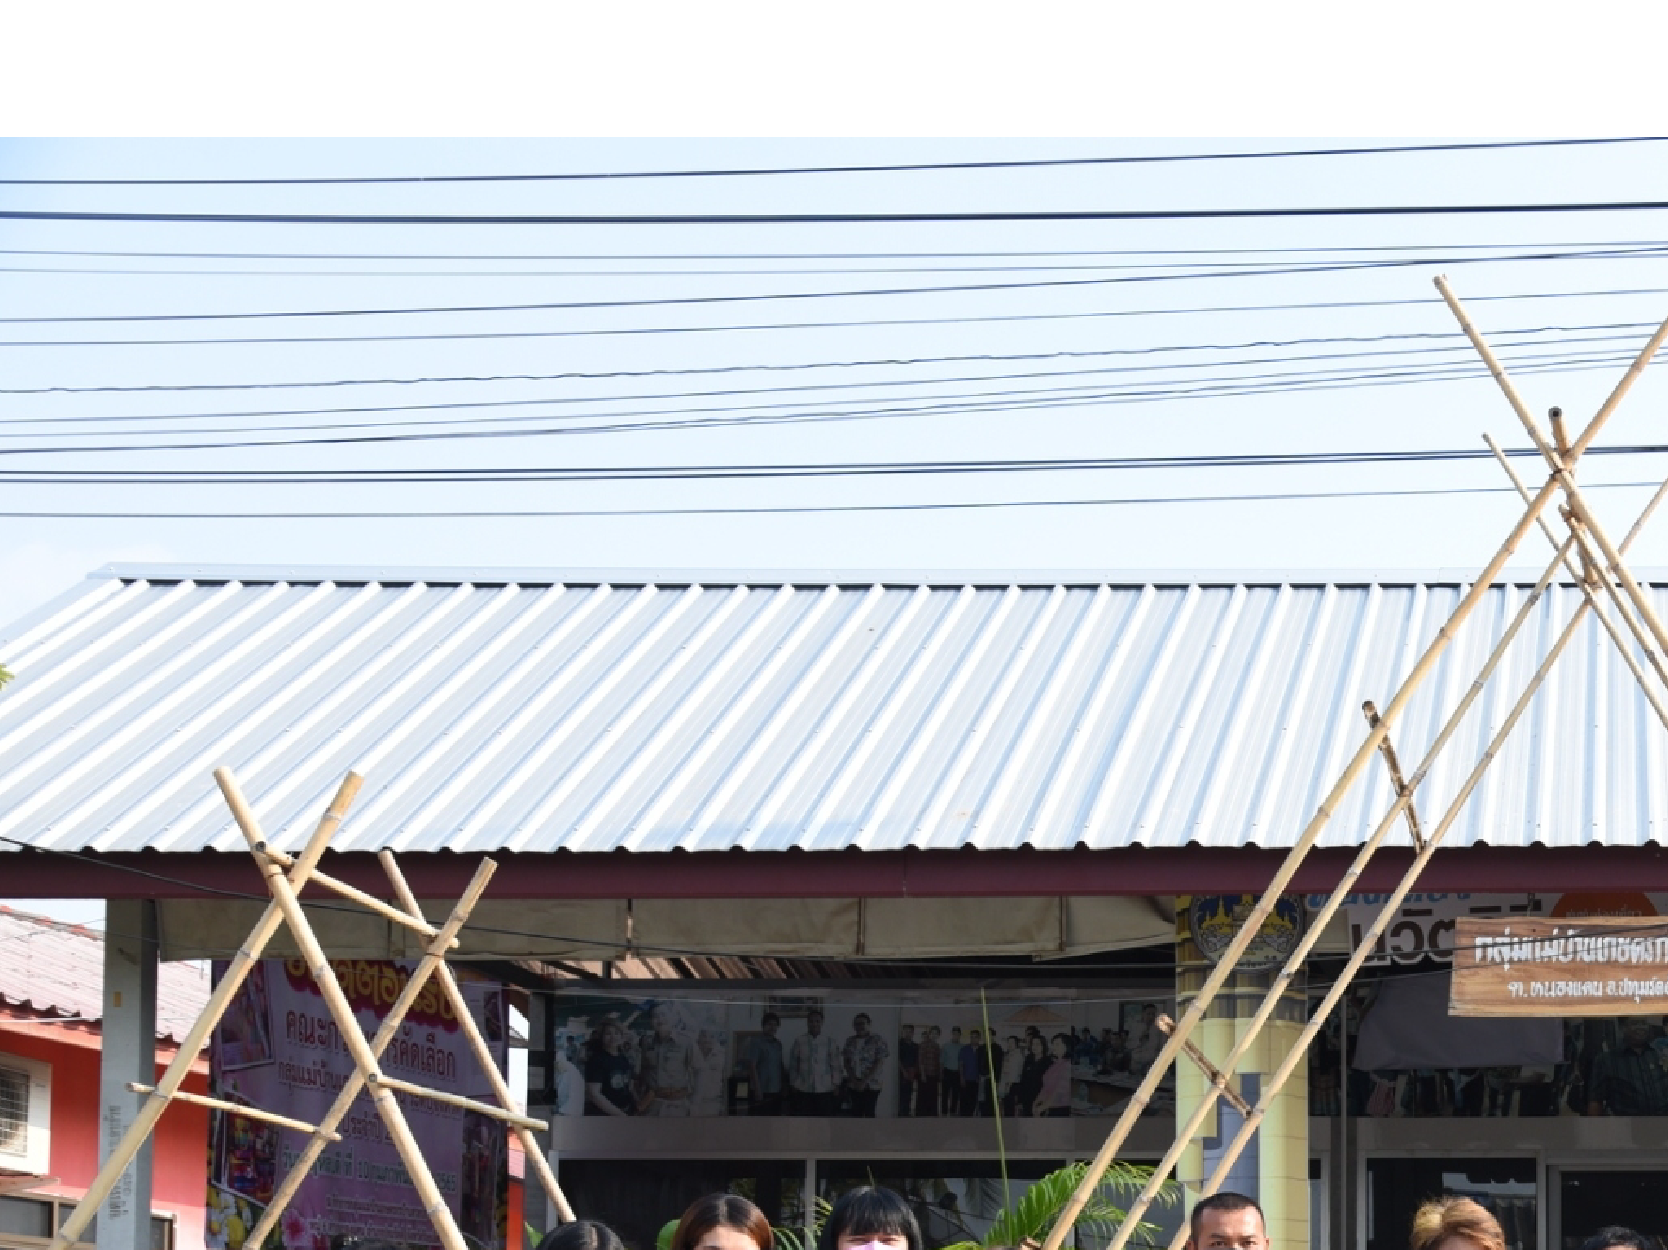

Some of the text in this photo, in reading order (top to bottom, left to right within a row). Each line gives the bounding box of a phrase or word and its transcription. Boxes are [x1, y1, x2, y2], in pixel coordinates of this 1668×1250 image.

[286, 1010, 457, 1079] คณะการคัดเลือก
